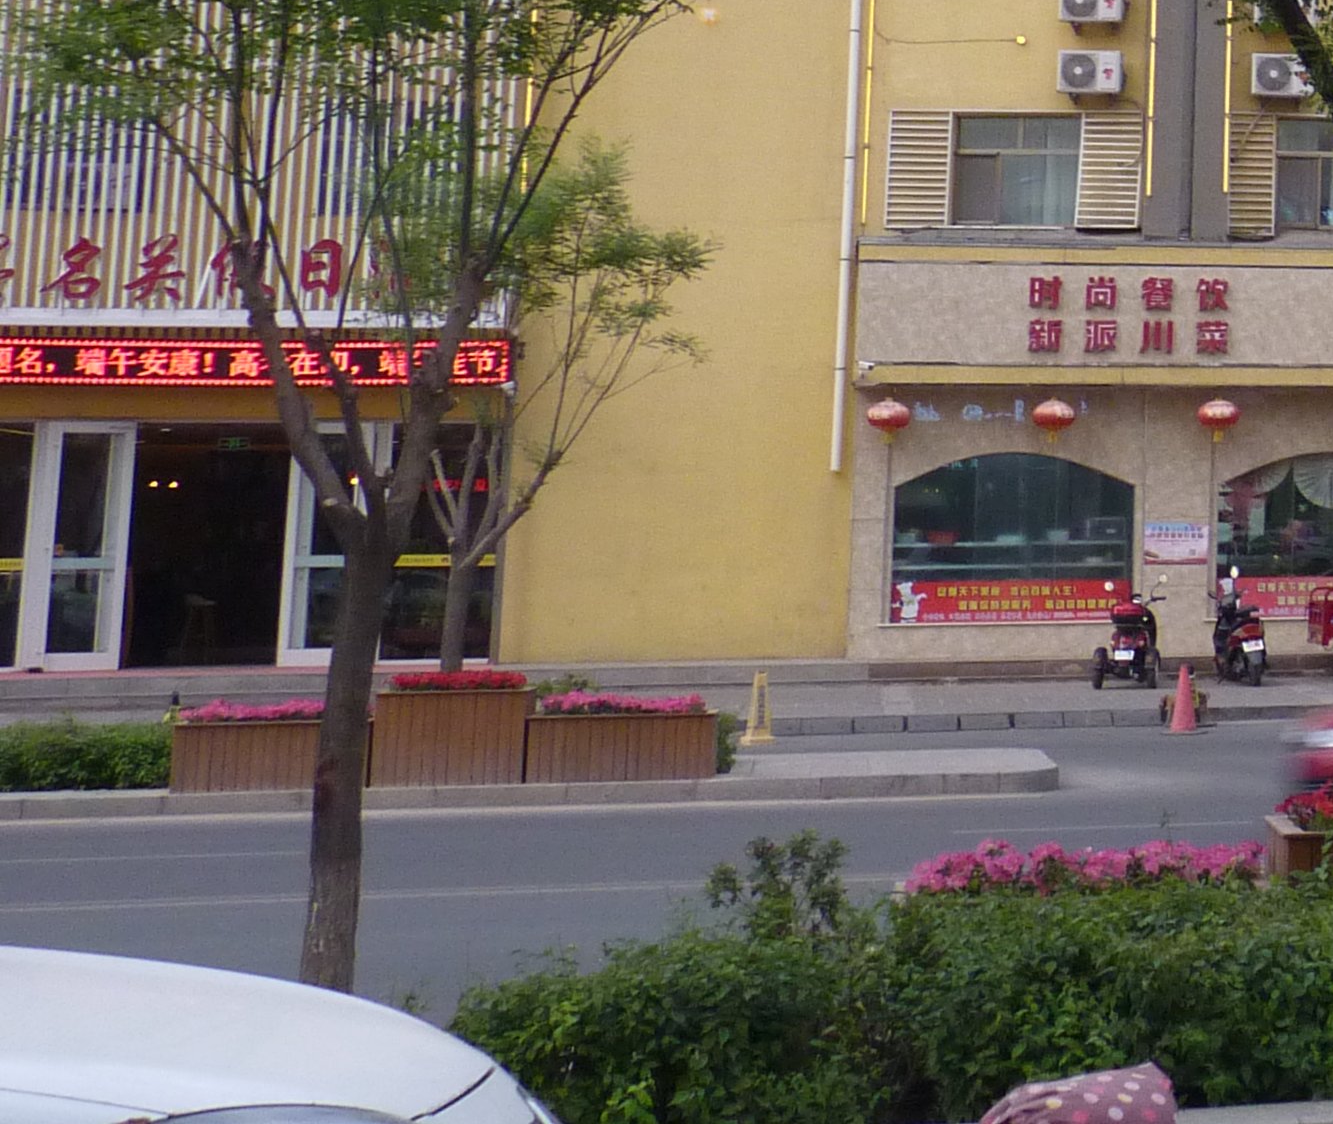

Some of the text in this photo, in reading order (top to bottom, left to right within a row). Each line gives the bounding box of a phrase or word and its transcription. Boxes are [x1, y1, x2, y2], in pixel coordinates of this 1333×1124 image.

[1028, 276, 1229, 311] 时尚餐饮
[1028, 318, 1229, 353] 新派川菜
